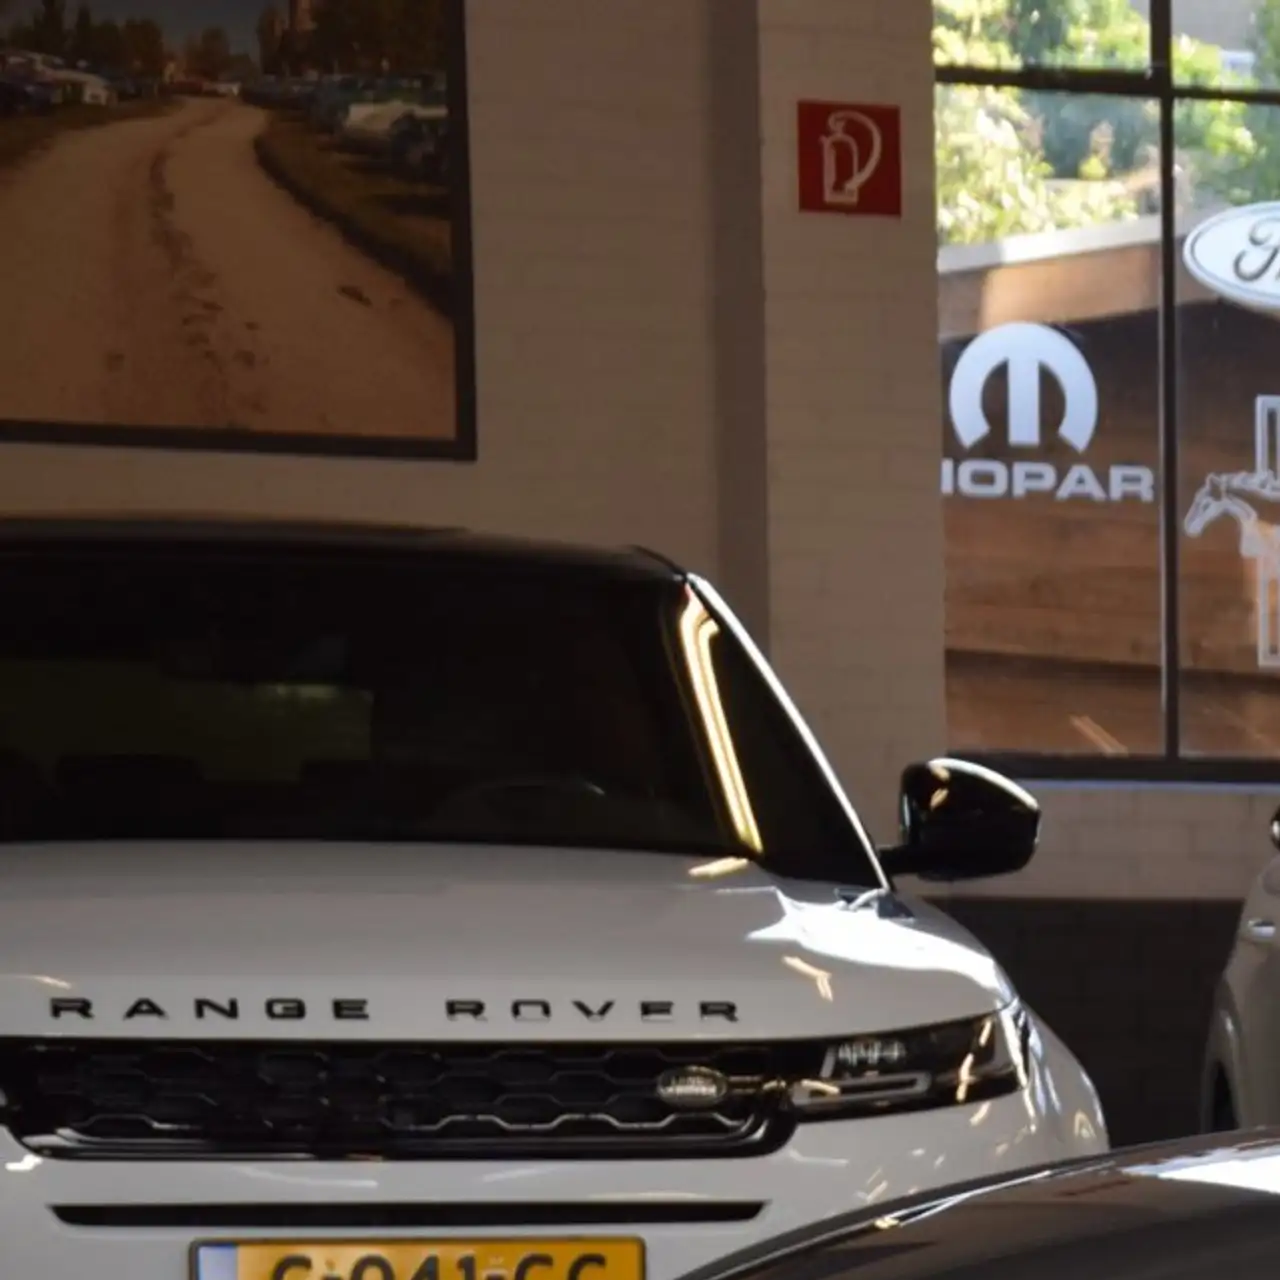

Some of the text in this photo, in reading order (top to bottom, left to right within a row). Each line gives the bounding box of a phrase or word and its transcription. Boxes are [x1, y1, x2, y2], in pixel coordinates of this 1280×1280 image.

[940, 457, 1155, 502] OPAR
[50, 997, 739, 1022] RANGE ROVER
